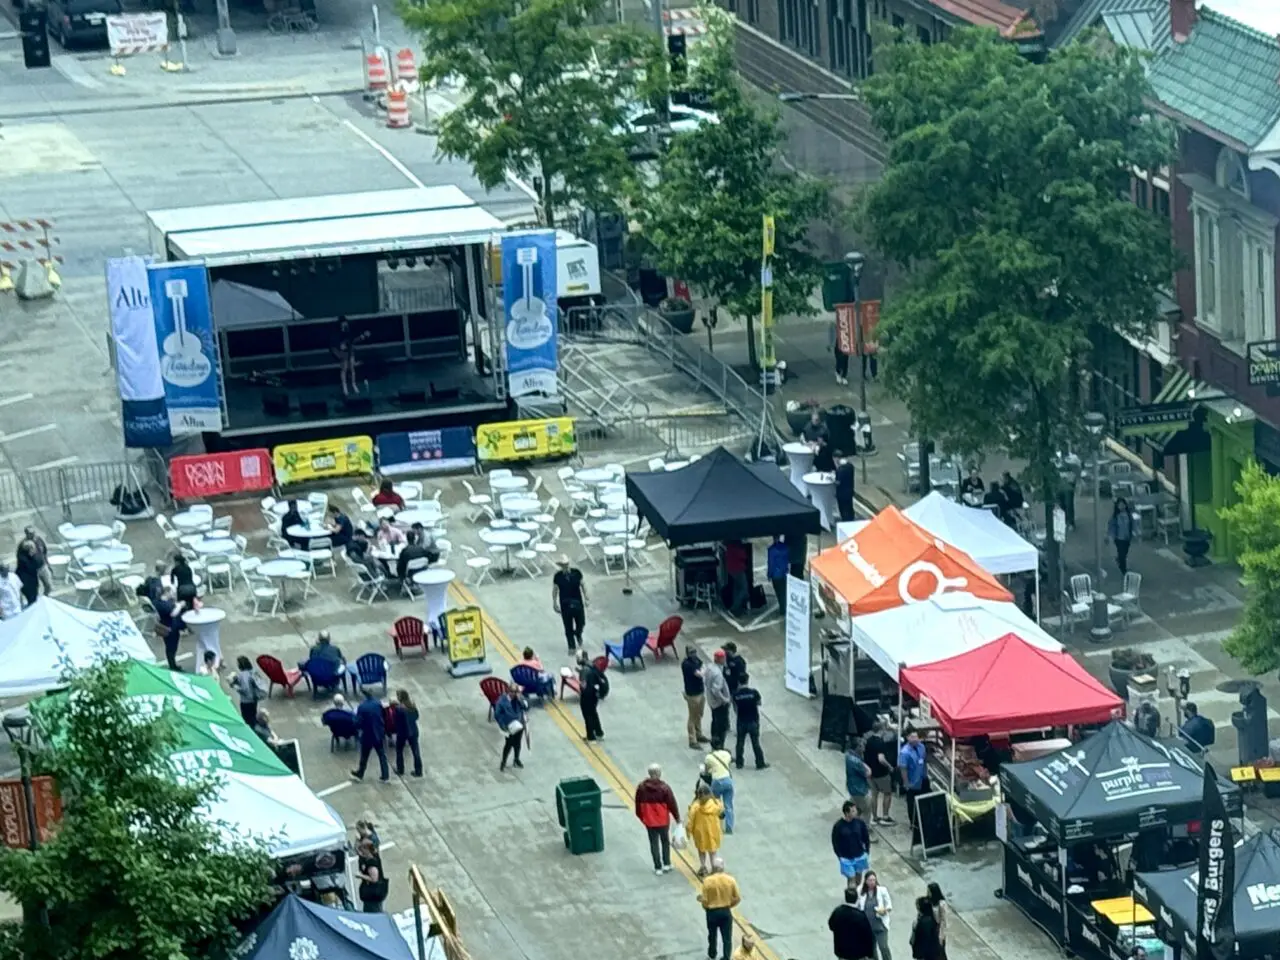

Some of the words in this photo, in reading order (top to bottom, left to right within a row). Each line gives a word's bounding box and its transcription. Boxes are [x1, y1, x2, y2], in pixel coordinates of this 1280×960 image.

[838, 306, 850, 351] EXPLORE
[1147, 412, 1190, 423] MARKET
[184, 460, 224, 476] DOWN
[188, 474, 226, 488] TOWN
[1101, 766, 1143, 792] purple
[1205, 819, 1225, 891] Burgers
